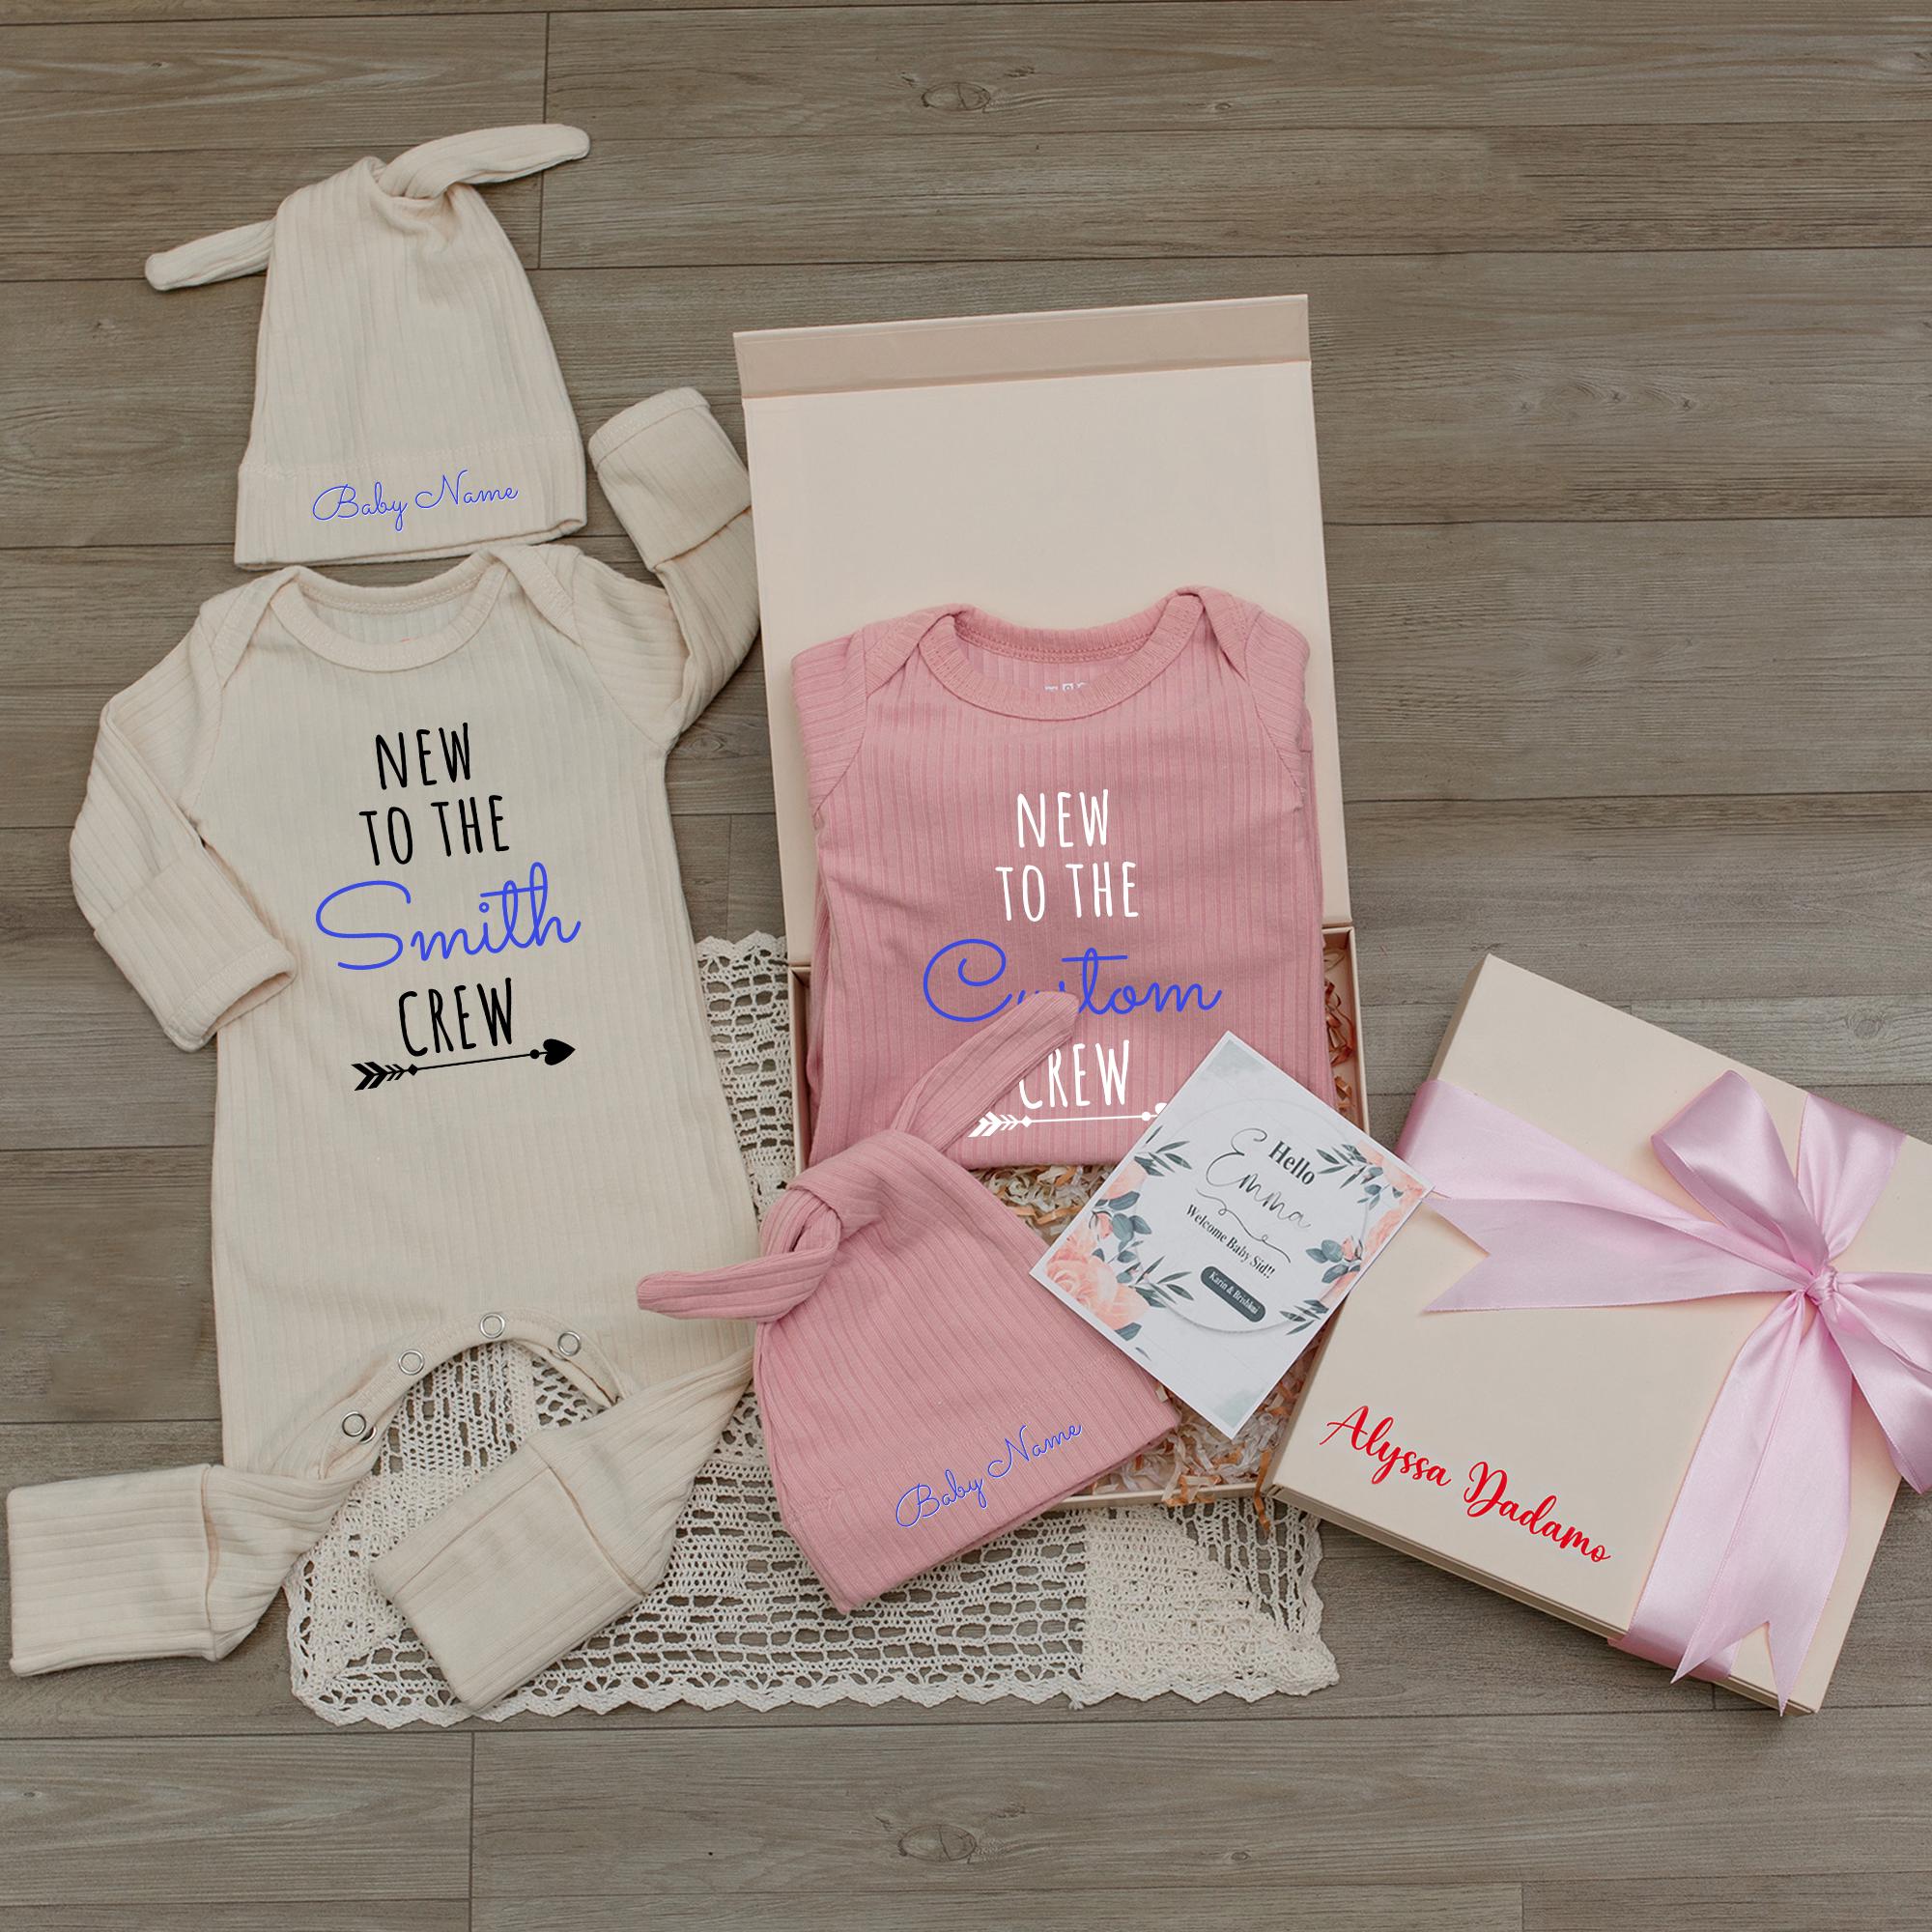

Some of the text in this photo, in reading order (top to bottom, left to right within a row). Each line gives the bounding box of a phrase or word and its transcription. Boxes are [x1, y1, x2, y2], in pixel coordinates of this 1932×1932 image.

[312, 469, 520, 532] Baby Name
[375, 722, 471, 790] NEW
[358, 794, 510, 867] TO THE
[1017, 788, 1109, 848] NEW
[315, 861, 582, 971] Smith
[995, 861, 1139, 923] TO THE
[398, 977, 513, 1057] CREW
[923, 938, 1223, 1023] Ctom
[1206, 1127, 1312, 1229] Emma
[1267, 1140, 1316, 1186] Hello
[1186, 1204, 1276, 1280] Welcome Baby Sid!!
[1208, 1270, 1228, 1291] Karin
[1226, 1285, 1235, 1295] &
[895, 1424, 1083, 1528] Baby Name
[1319, 1405, 1611, 1563] Alyssa Dadamo
